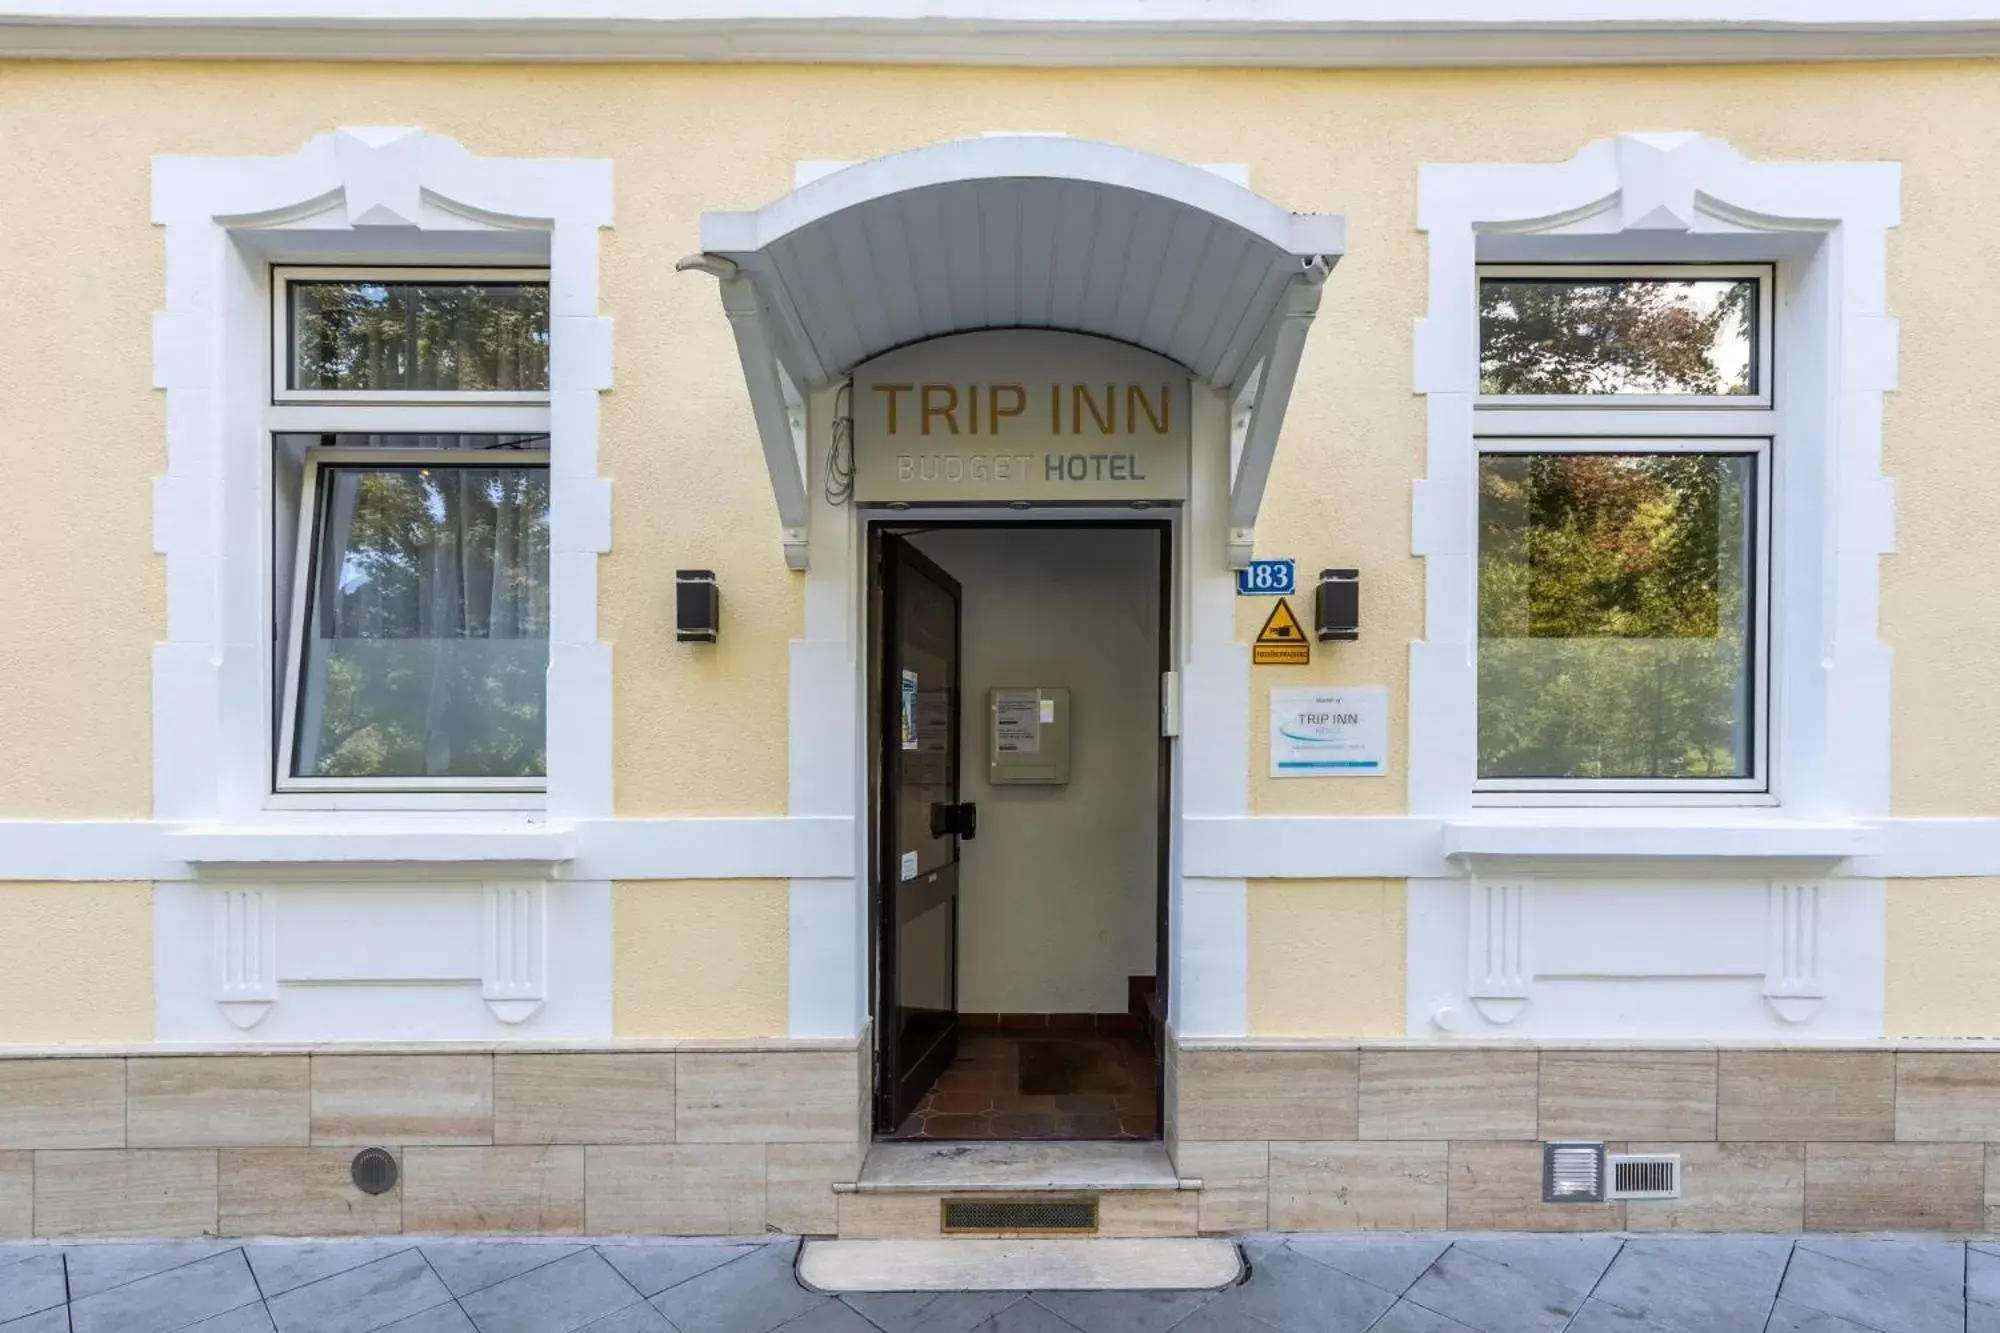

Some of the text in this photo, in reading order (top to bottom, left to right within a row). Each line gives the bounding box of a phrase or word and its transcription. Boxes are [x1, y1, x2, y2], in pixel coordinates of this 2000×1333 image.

[871, 382, 1170, 435] TRIP INN
[897, 453, 1146, 482] BUDGET HOTEL
[1247, 565, 1289, 589] 183
[1298, 713, 1359, 725] TRIP INN
